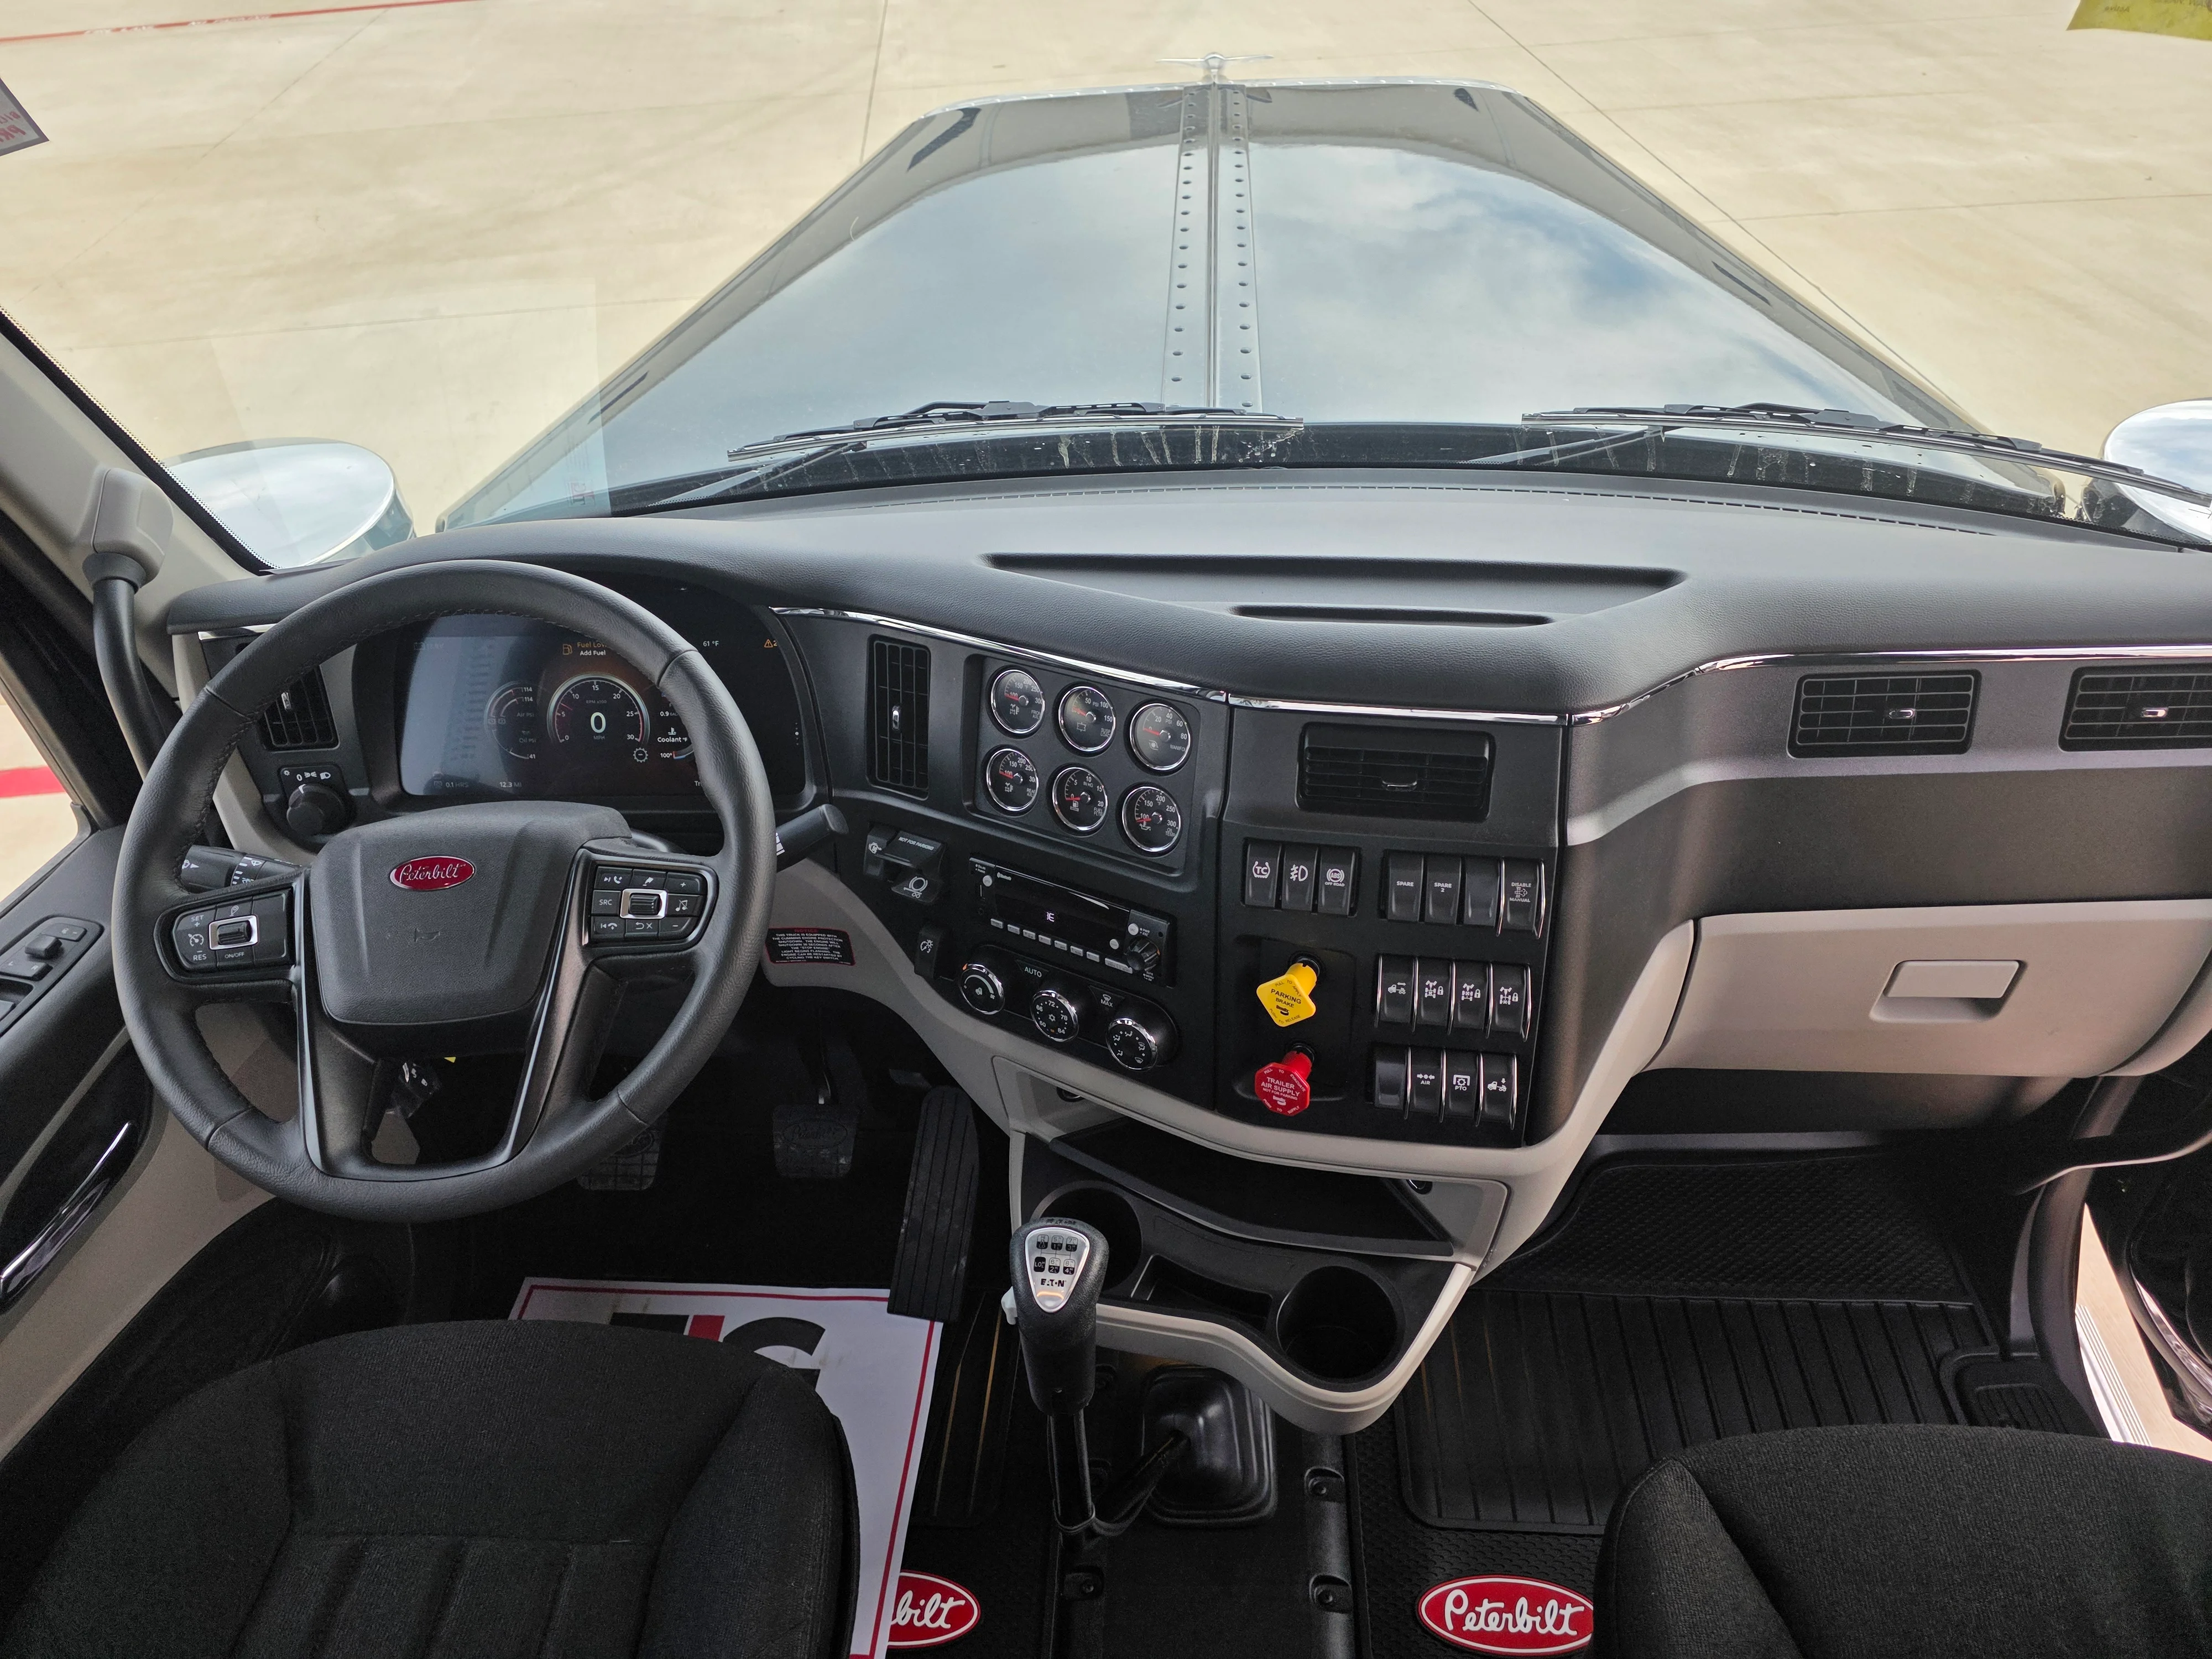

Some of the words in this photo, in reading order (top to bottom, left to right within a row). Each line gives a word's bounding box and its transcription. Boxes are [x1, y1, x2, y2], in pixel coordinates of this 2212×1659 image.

[590, 712, 606, 733] 0
[915, 842, 934, 851] PARKING
[399, 863, 466, 883] Peterbilt
[1255, 866, 1267, 875] TC
[1024, 966, 1042, 978] AUTO
[1271, 988, 1302, 1004] PARKING
[1292, 985, 1302, 997] APPLY
[1100, 999, 1113, 1008] MAX
[1275, 997, 1295, 1008] BRAKE
[1269, 1008, 1277, 1018] PUSH
[1285, 1014, 1301, 1022] RELEASE
[1266, 1077, 1295, 1090] TRAILER
[1290, 1073, 1306, 1092] EVACUATE
[1274, 1085, 1300, 1097] SUPPLY
[1280, 1092, 1298, 1100] PARKING
[1263, 1098, 1272, 1108] PUSH
[1287, 1105, 1300, 1114] SUPPLY
[1444, 1589, 1585, 1636] Peterbilt
